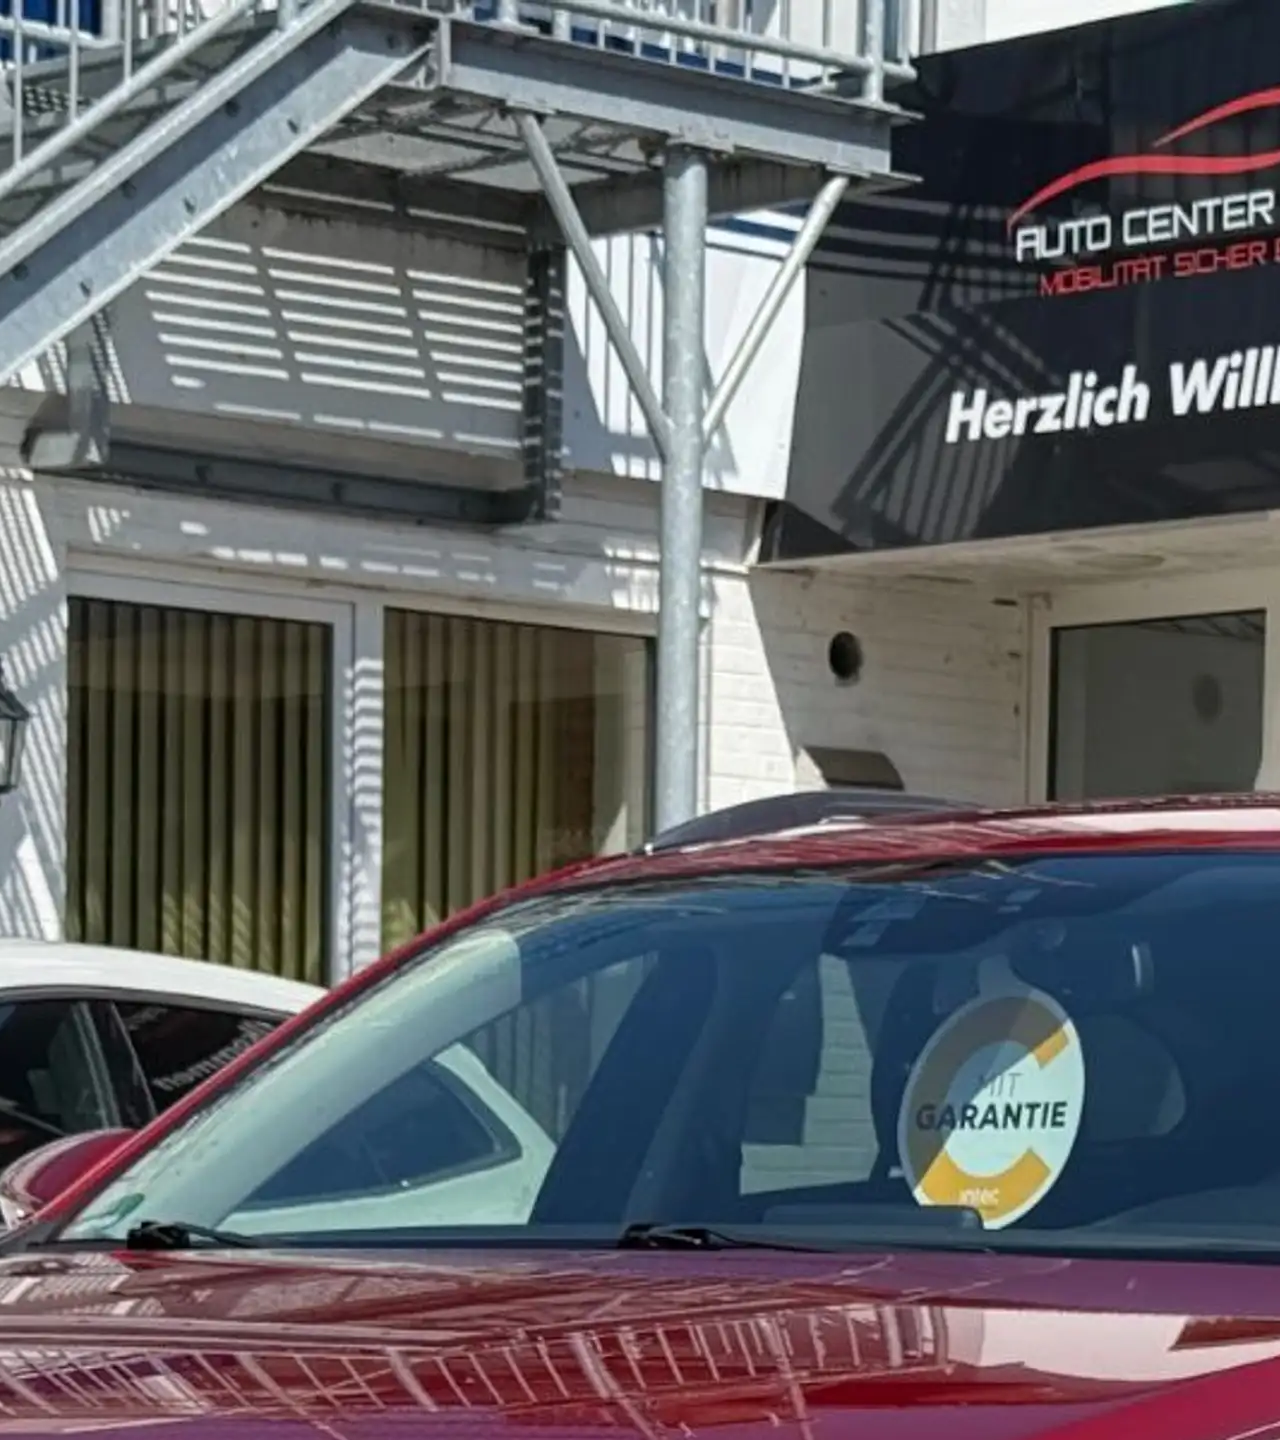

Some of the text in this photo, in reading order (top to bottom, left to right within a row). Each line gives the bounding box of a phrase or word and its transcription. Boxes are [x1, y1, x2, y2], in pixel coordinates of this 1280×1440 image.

[1015, 215, 1111, 261] AUTO
[1123, 192, 1274, 247] CENTER
[1174, 241, 1266, 278] SICHER
[945, 365, 1149, 444] Herzlich
[917, 1101, 1067, 1130] GARANTIE
